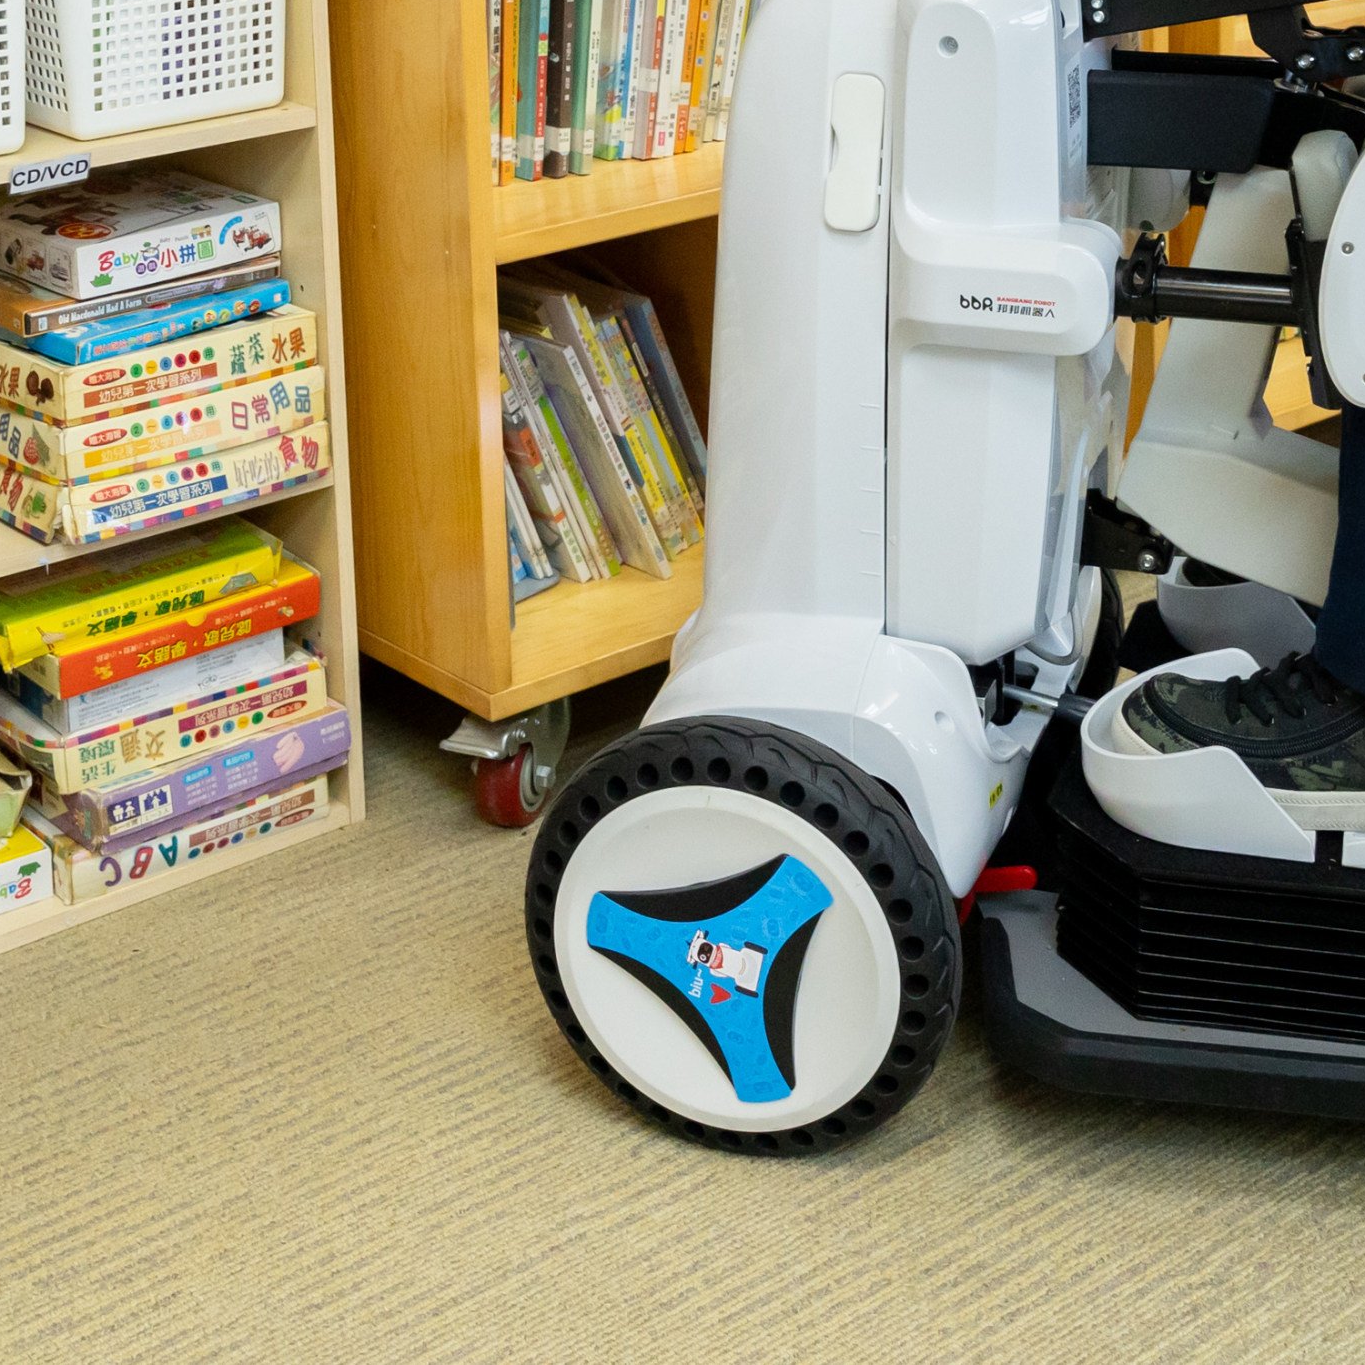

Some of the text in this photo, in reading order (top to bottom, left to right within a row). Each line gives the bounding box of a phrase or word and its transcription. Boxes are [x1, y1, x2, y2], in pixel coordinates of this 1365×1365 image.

[11, 158, 90, 189] CD/VCD
[97, 250, 141, 273] Baby
[158, 239, 215, 270] 小拼圖
[996, 295, 1033, 304] BANGBANG
[996, 303, 1055, 319] 邦邦机器人
[230, 327, 308, 376] 蔬菜水果
[98, 368, 204, 405] 幼兒第一次學習系列
[231, 381, 313, 432] 日常用品
[98, 425, 208, 463] 幼兒第一次學習系列
[233, 435, 321, 488] 好吃的食物
[108, 480, 215, 519] 幼兒第一次學習系列
[195, 685, 294, 727] 幼兒第一次學習系列
[78, 741, 118, 763] 環境
[120, 726, 168, 762] 交通
[81, 759, 118, 784] 生活
